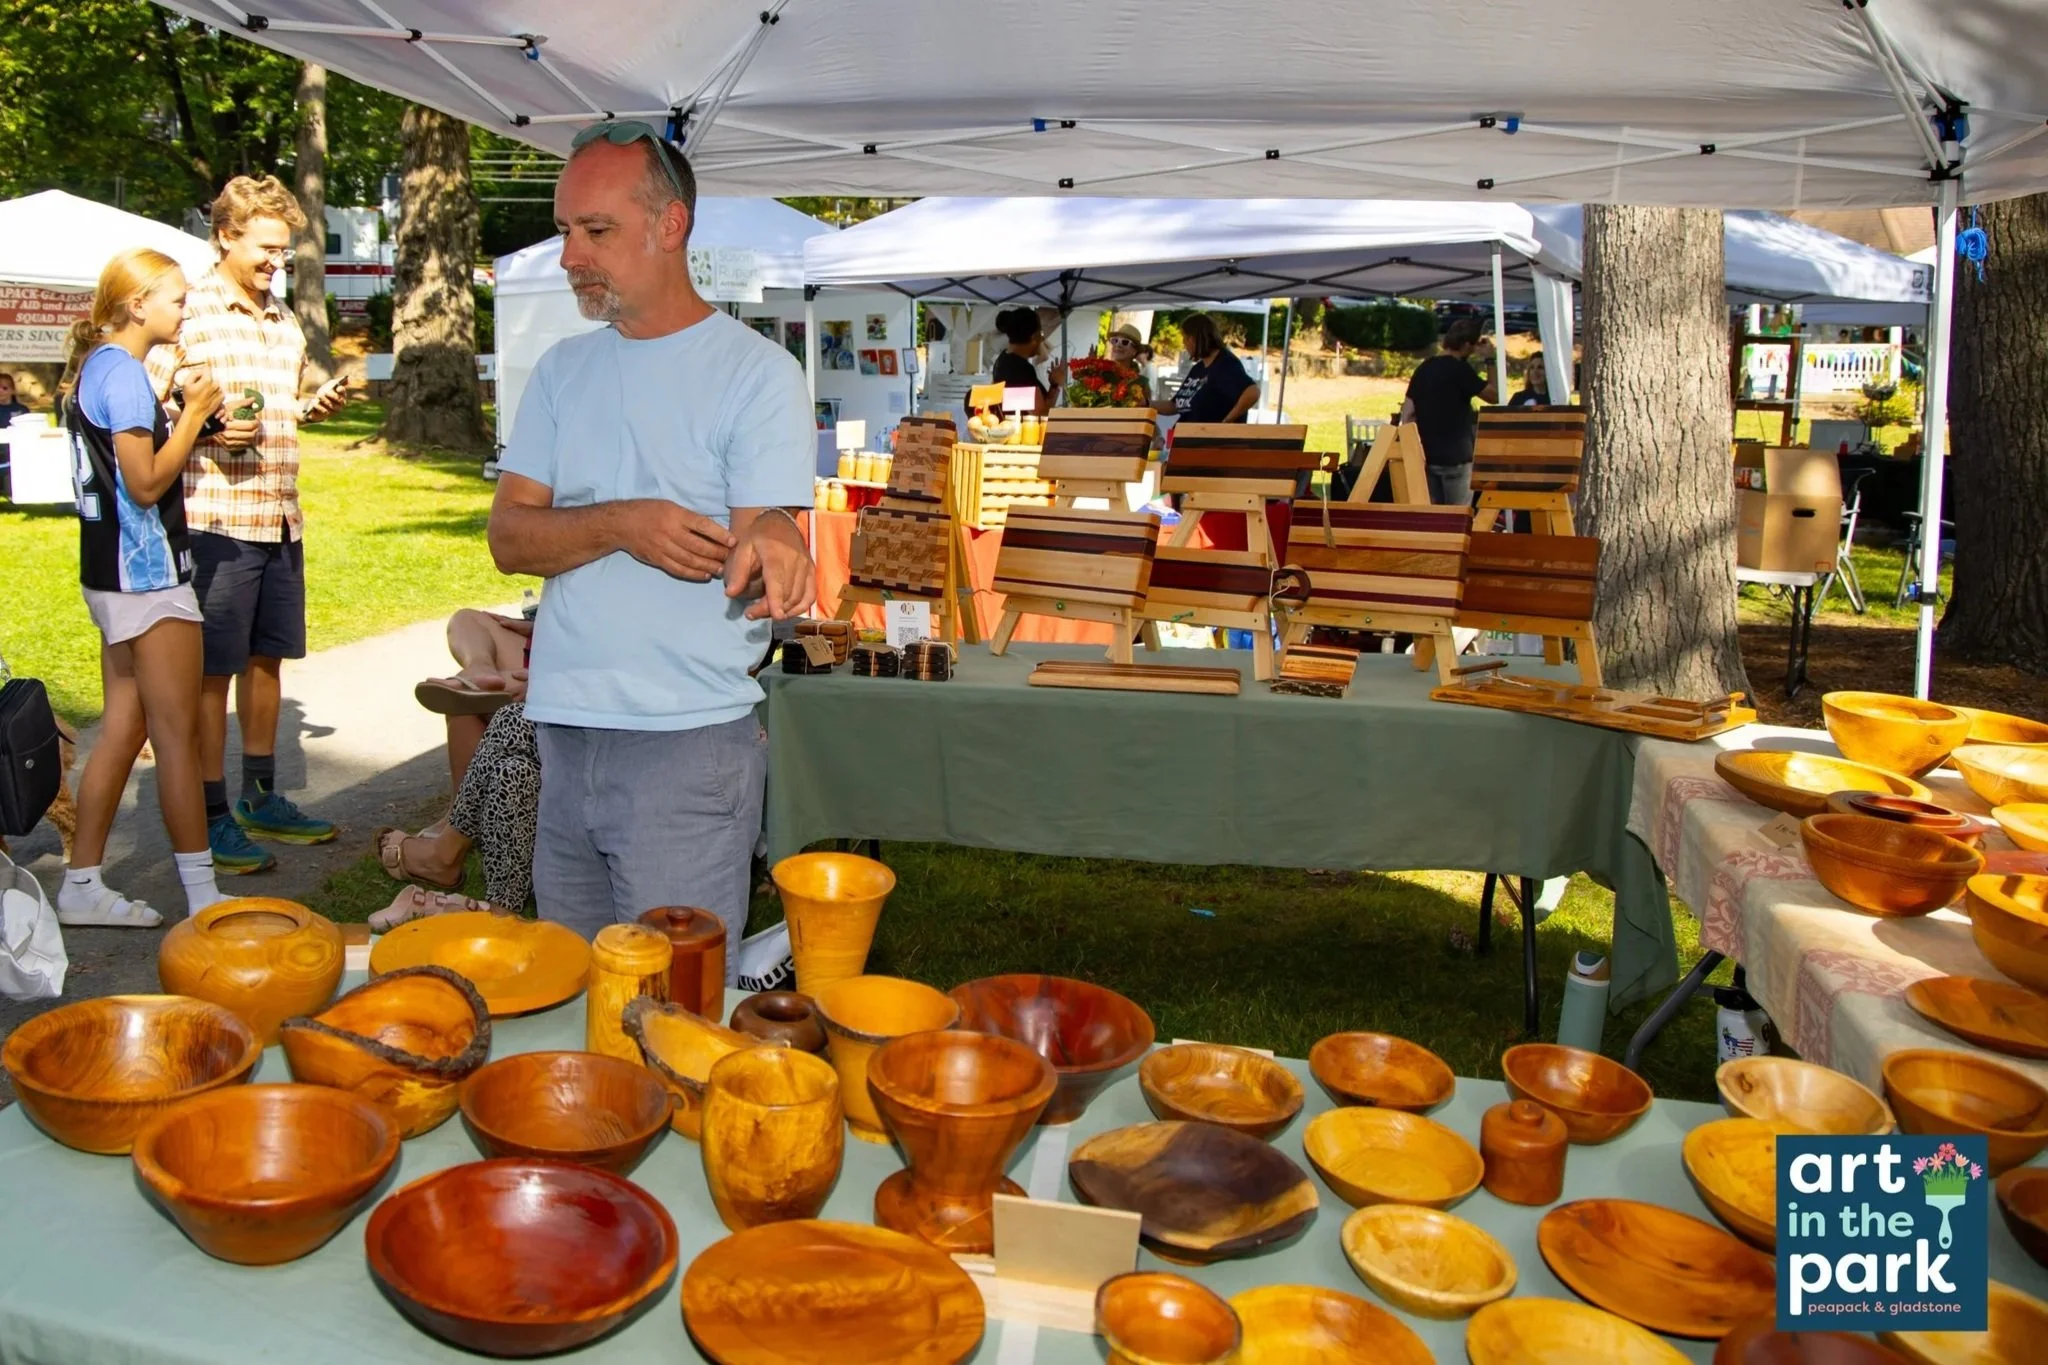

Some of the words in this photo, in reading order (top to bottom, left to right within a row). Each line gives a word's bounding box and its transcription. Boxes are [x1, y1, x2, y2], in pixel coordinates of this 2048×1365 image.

[20, 300, 41, 310] AID
[16, 313, 55, 324] SQUAD
[28, 330, 66, 341] SINC
